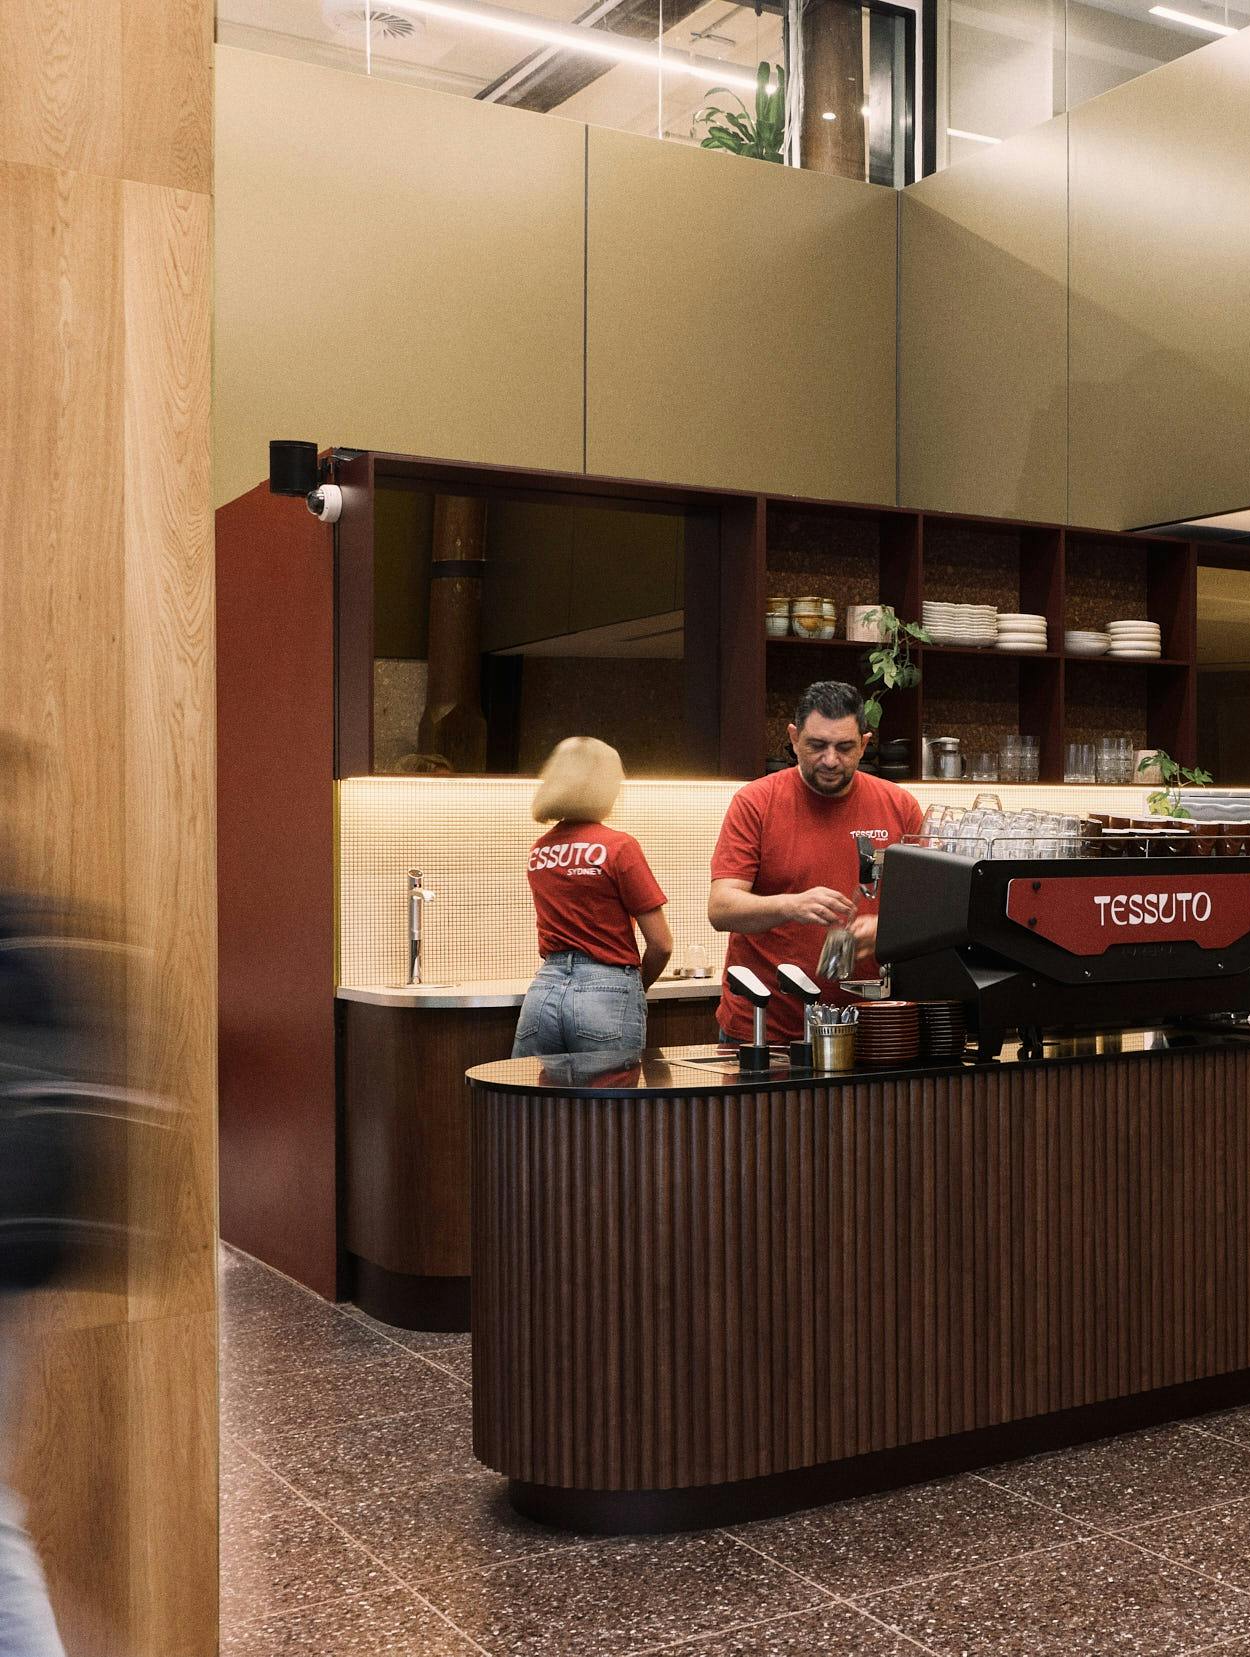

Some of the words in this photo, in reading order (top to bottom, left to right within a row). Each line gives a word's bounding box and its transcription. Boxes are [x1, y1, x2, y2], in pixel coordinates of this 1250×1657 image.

[528, 842, 607, 871] ESSUTO
[567, 867, 602, 876] SYDNEY
[1093, 891, 1212, 926] TESSUTO
